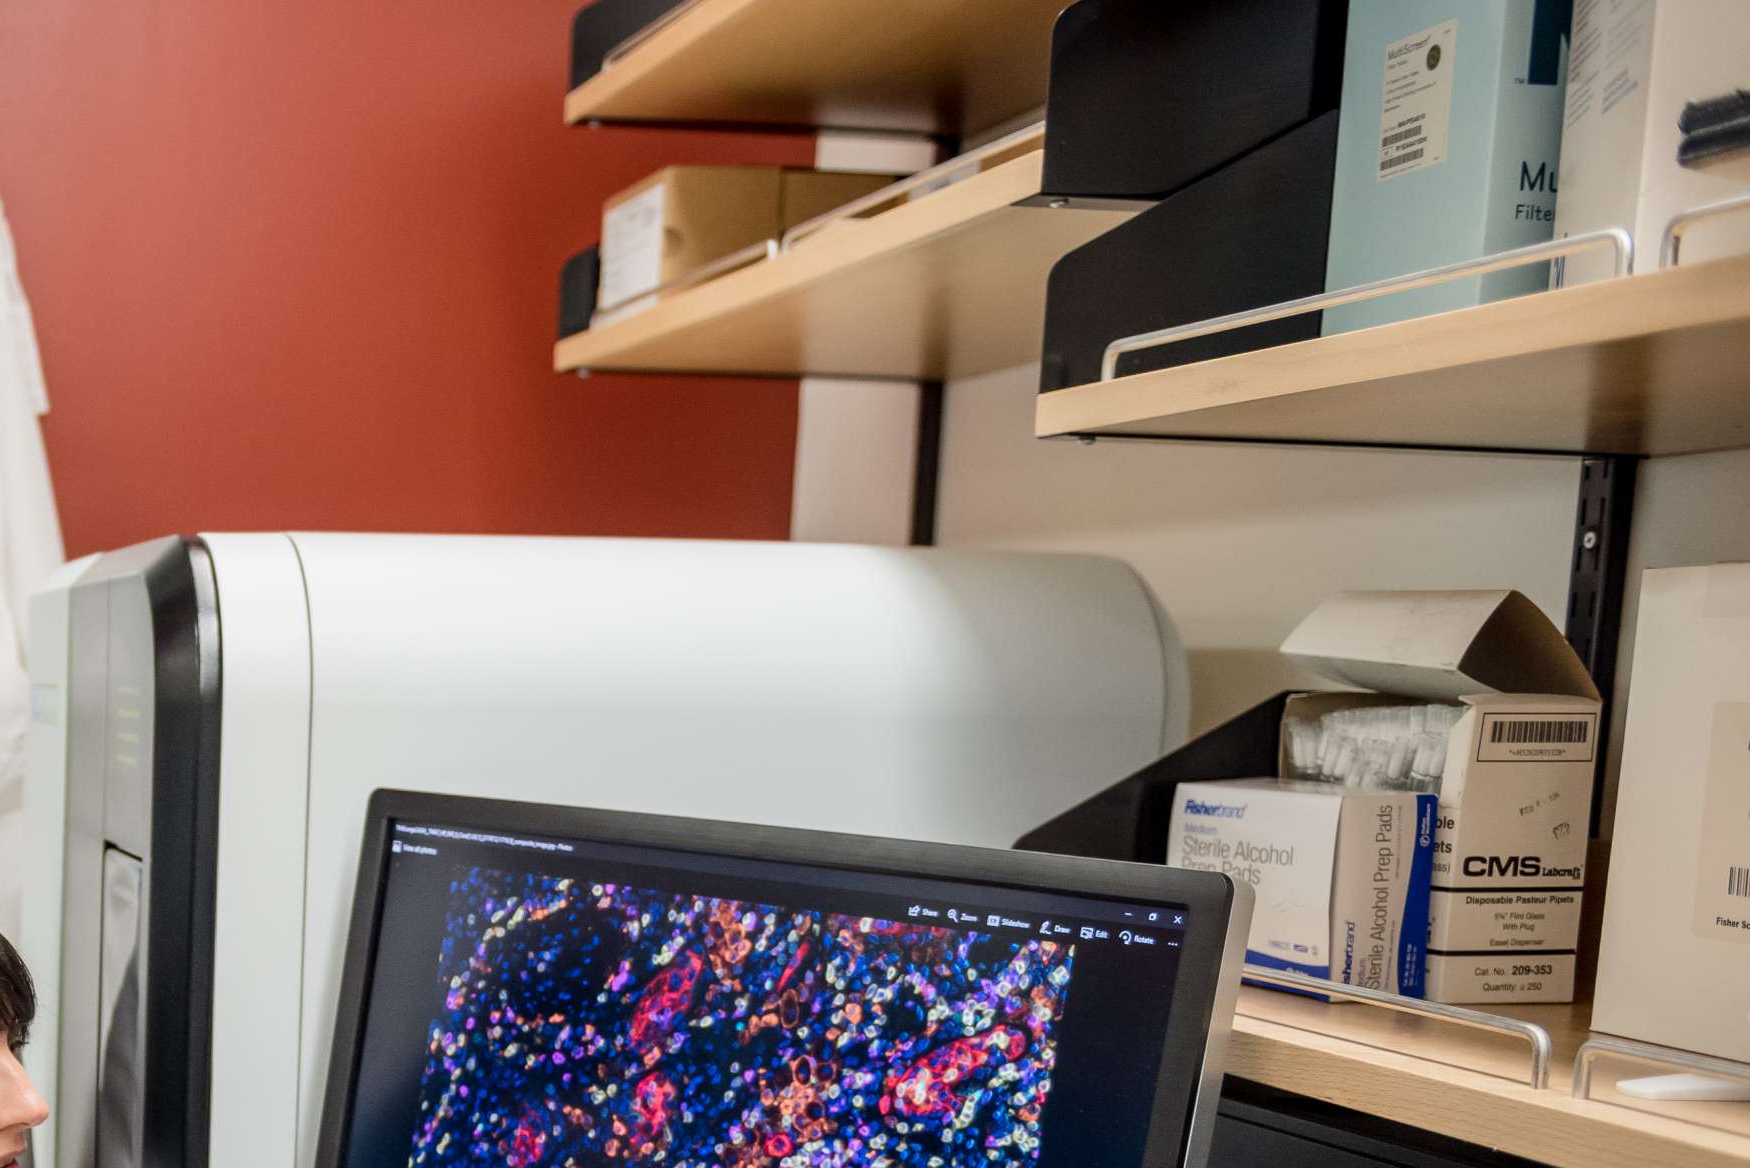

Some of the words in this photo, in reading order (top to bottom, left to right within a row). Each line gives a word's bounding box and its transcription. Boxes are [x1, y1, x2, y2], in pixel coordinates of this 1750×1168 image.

[1184, 800, 1247, 819] Fisherbrand
[1375, 804, 1393, 843] Pads
[1183, 836, 1230, 860] Sterile
[1233, 840, 1294, 867] Alcohol
[1373, 846, 1394, 883] Prep
[1463, 856, 1541, 877] CMS
[1465, 896, 1513, 905] Disposable
[1515, 895, 1547, 904] Pasteur
[1549, 895, 1574, 905] Pipets
[1370, 886, 1390, 942] Alcohol
[1525, 912, 1545, 920] Glass
[1519, 923, 1535, 931] Plug
[1716, 916, 1739, 928] Fisher
[1510, 938, 1544, 947] Dispenser
[1365, 944, 1385, 990] Sterile
[1511, 965, 1552, 976] 209-353
[1527, 983, 1542, 991] 250
